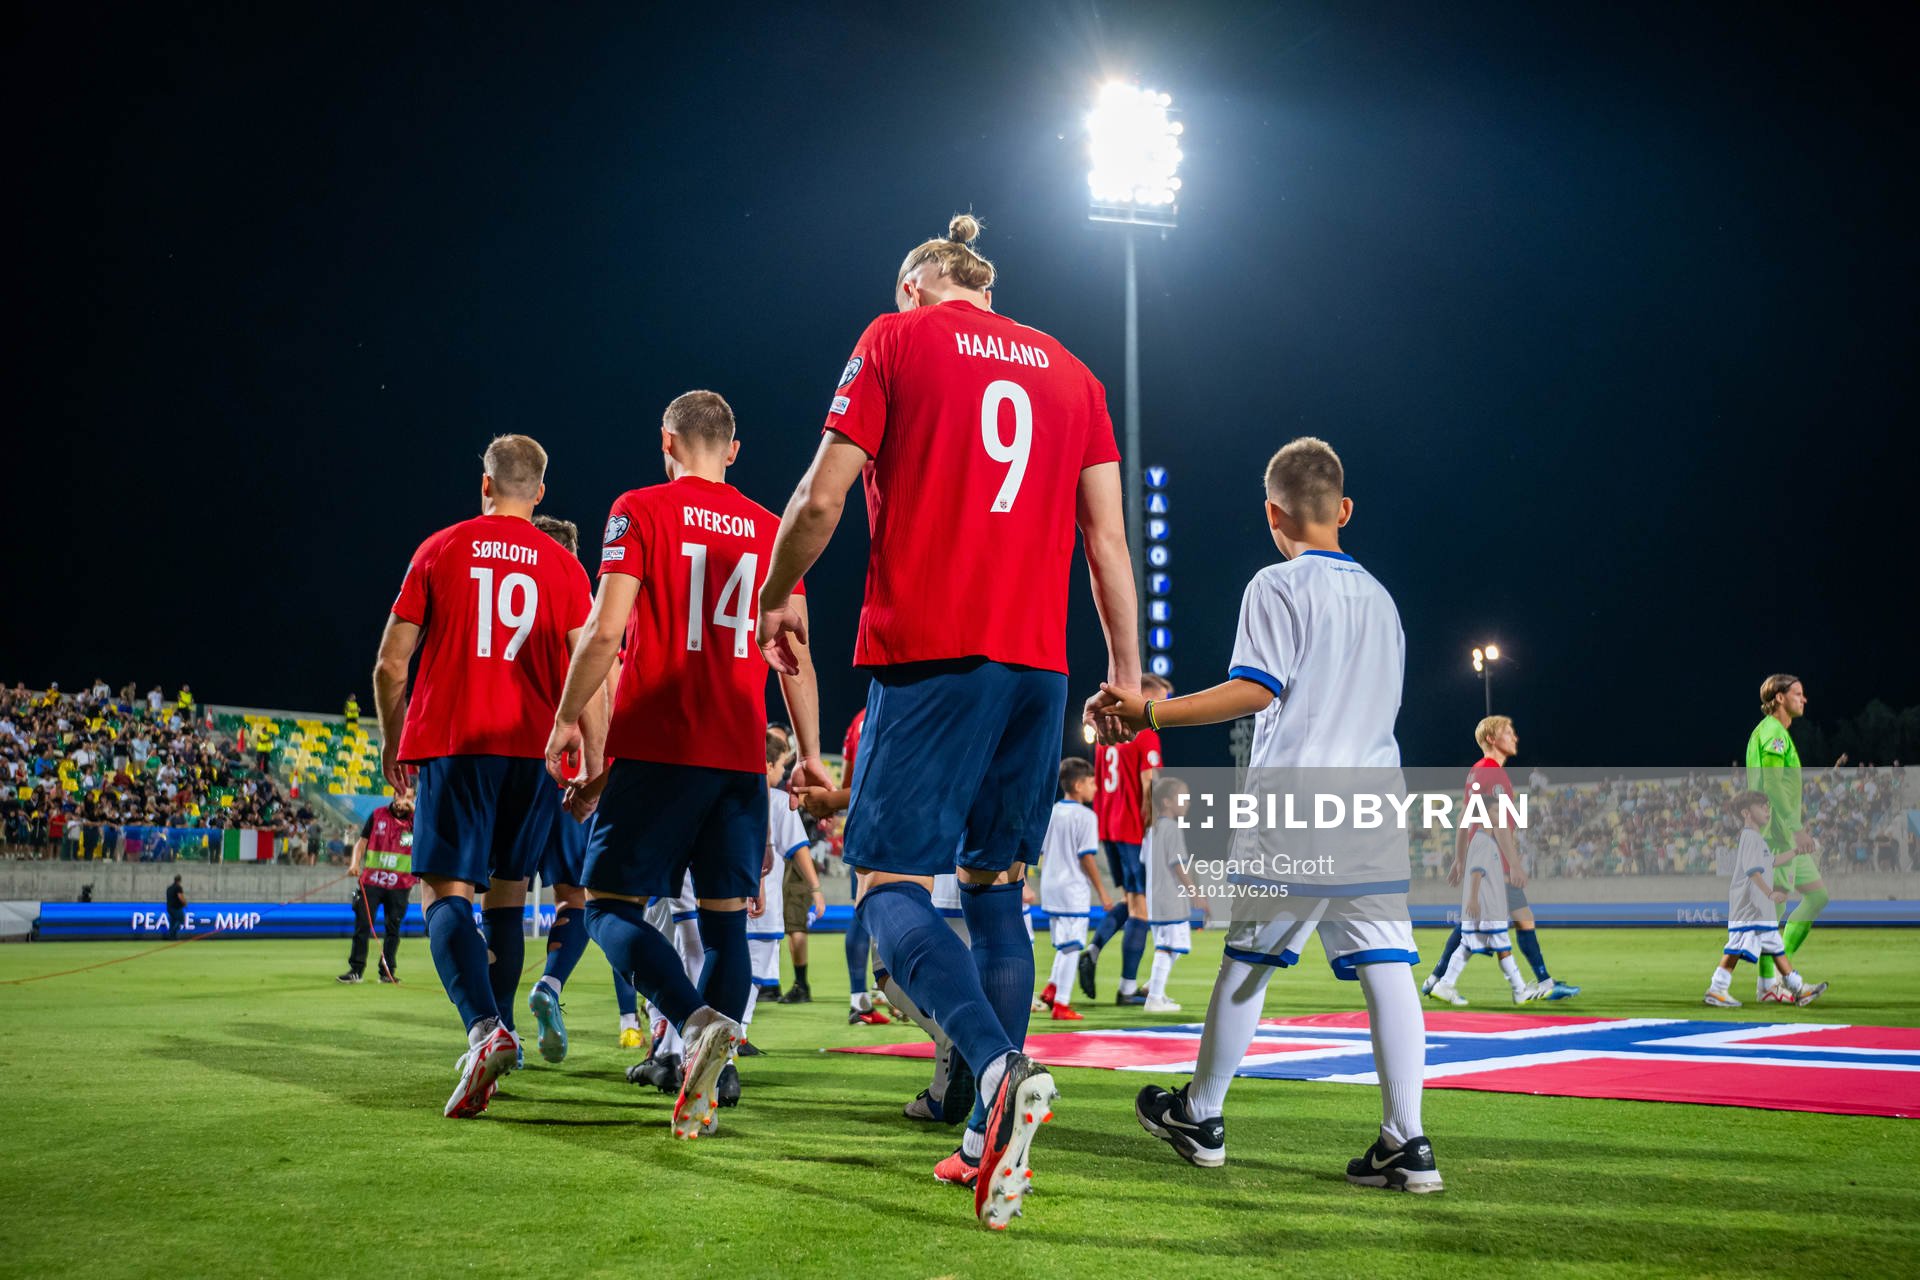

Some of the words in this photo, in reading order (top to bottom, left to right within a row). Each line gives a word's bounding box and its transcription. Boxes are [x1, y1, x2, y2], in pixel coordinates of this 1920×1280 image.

[955, 332, 1050, 368] HAALAND
[981, 379, 1033, 513] 9
[683, 506, 756, 538] RYERSON
[472, 540, 538, 566] SØRLOTH
[470, 566, 539, 662] 19
[681, 542, 758, 659] 14
[1104, 745, 1119, 793] 3
[369, 871, 398, 886] 429
[132, 911, 196, 930] PEAE
[215, 911, 261, 930] МИР
[1677, 908, 1720, 923] PEACE
